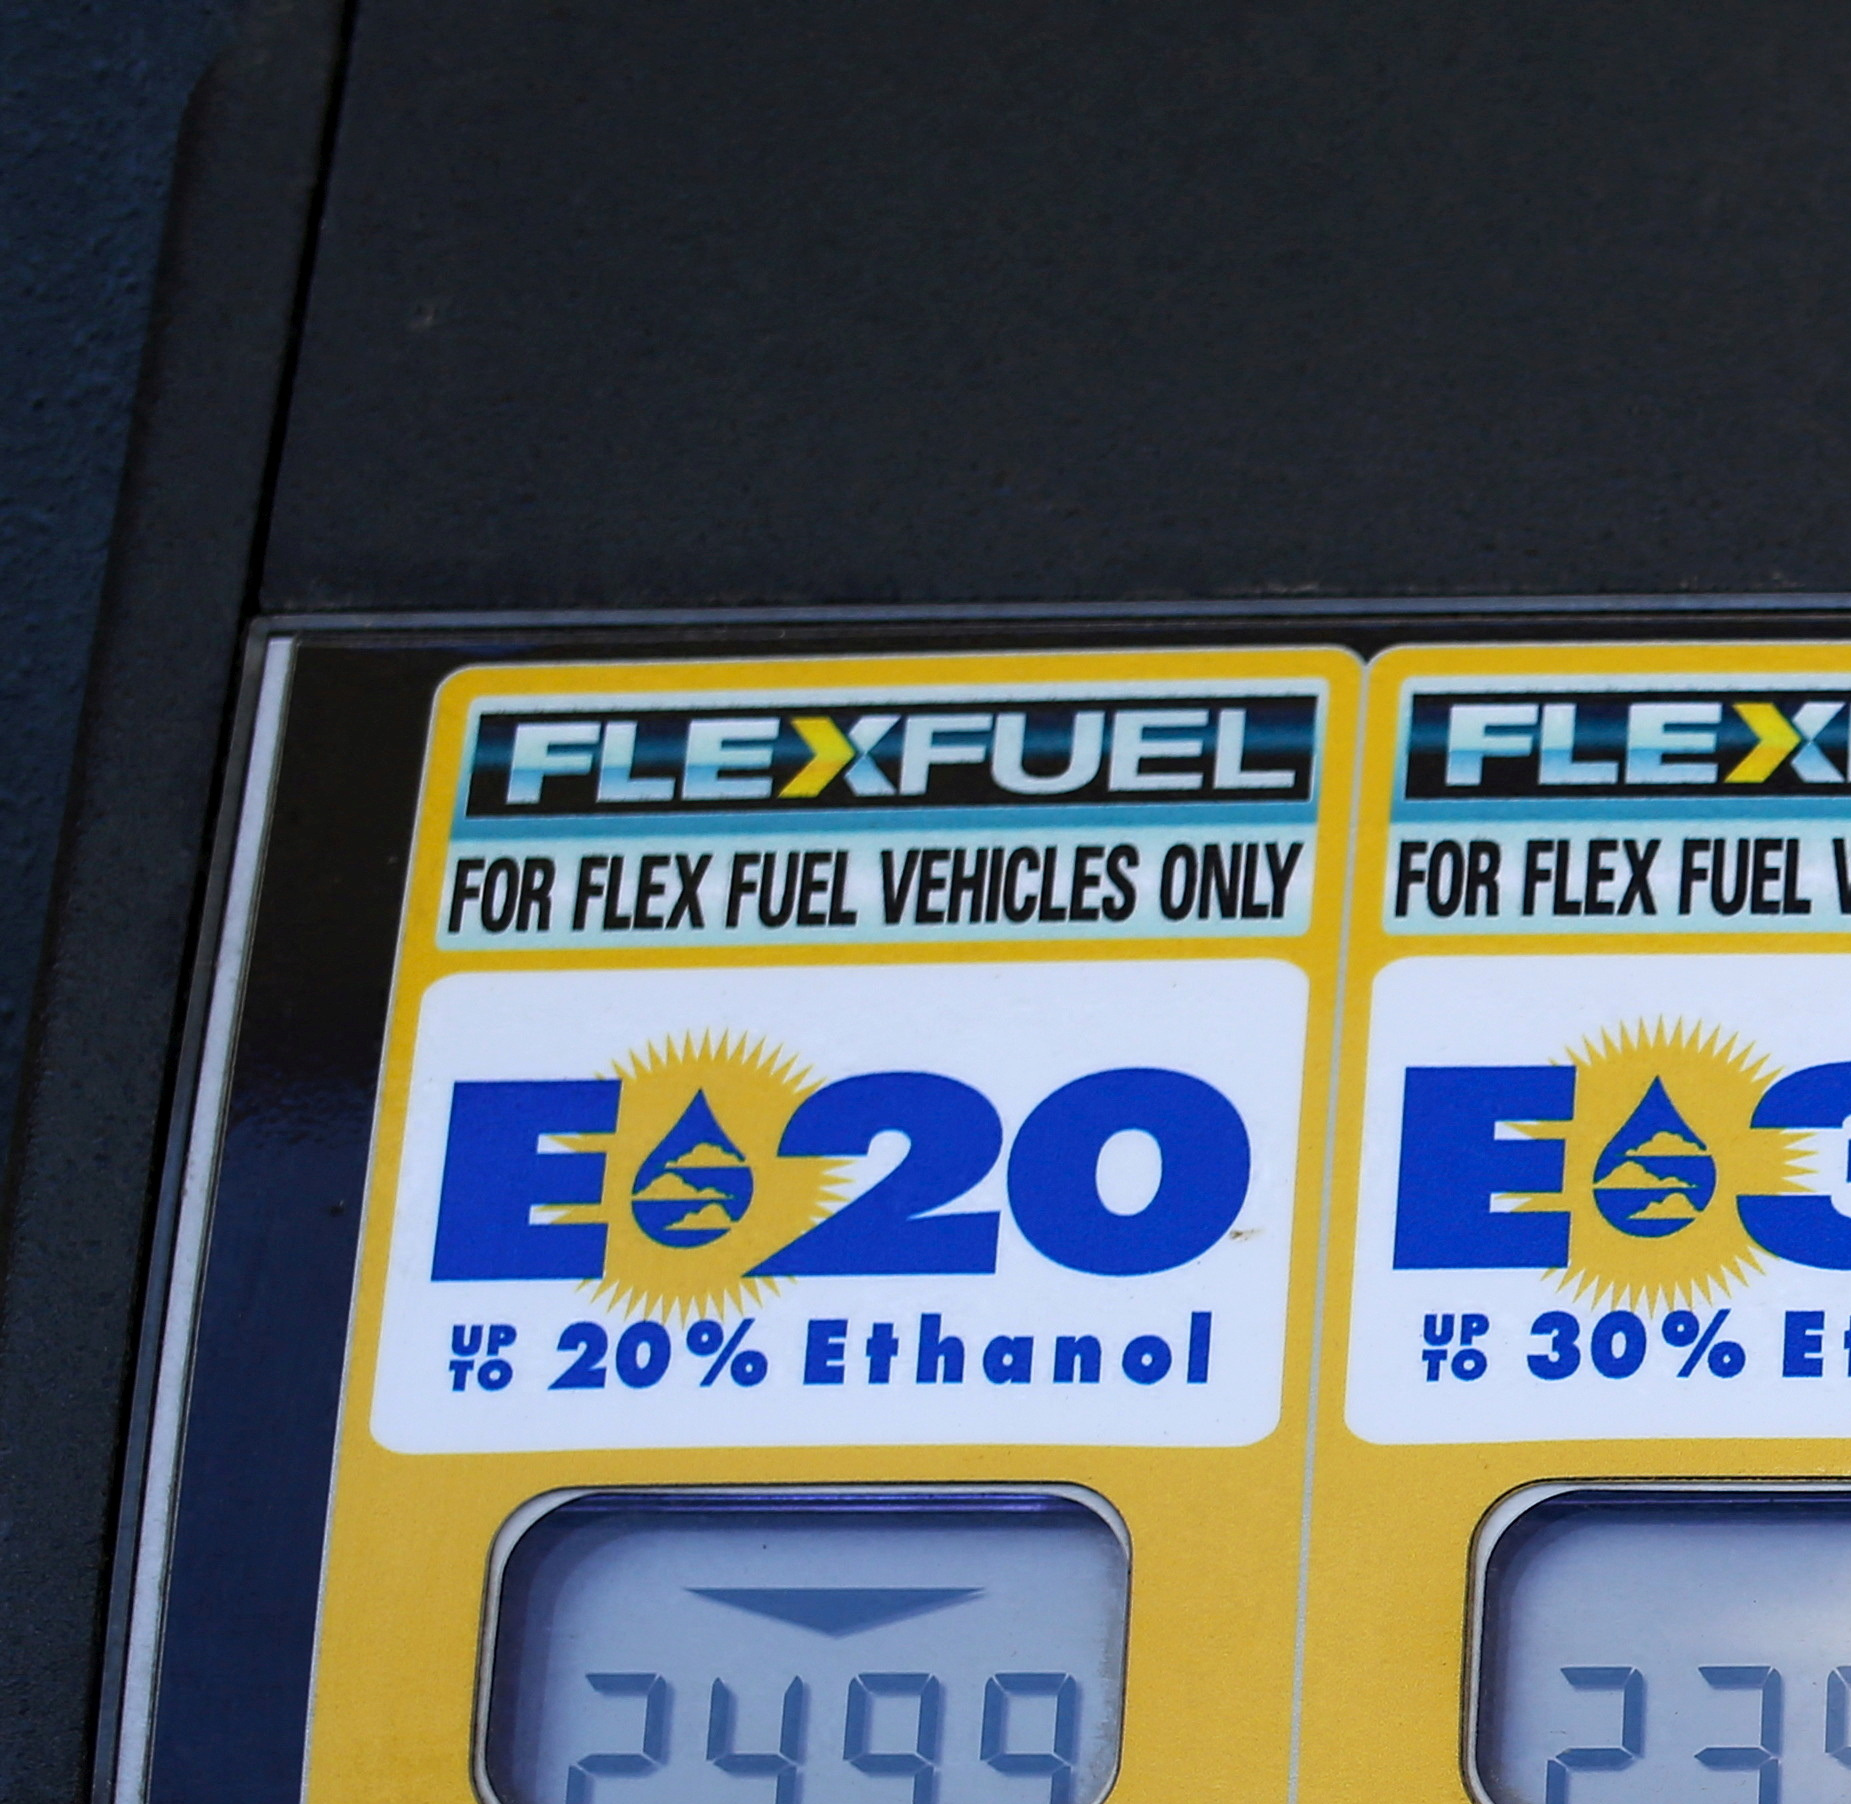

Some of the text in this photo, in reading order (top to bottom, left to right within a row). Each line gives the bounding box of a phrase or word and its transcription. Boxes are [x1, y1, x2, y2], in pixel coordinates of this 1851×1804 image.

[506, 707, 1295, 805] FLEXFUEL
[448, 842, 1303, 933] FOR FLEX FUEL VEHICLES ONLY
[1394, 838, 1500, 917] FOR
[1521, 838, 1661, 917] FLEX
[1678, 838, 1811, 916] FUEL
[449, 1310, 1212, 1392] UP TO 20% Ethanol
[1422, 1349, 1487, 1381] TO
[1423, 1313, 1490, 1345] UP
[1526, 1308, 1747, 1379] 30%
